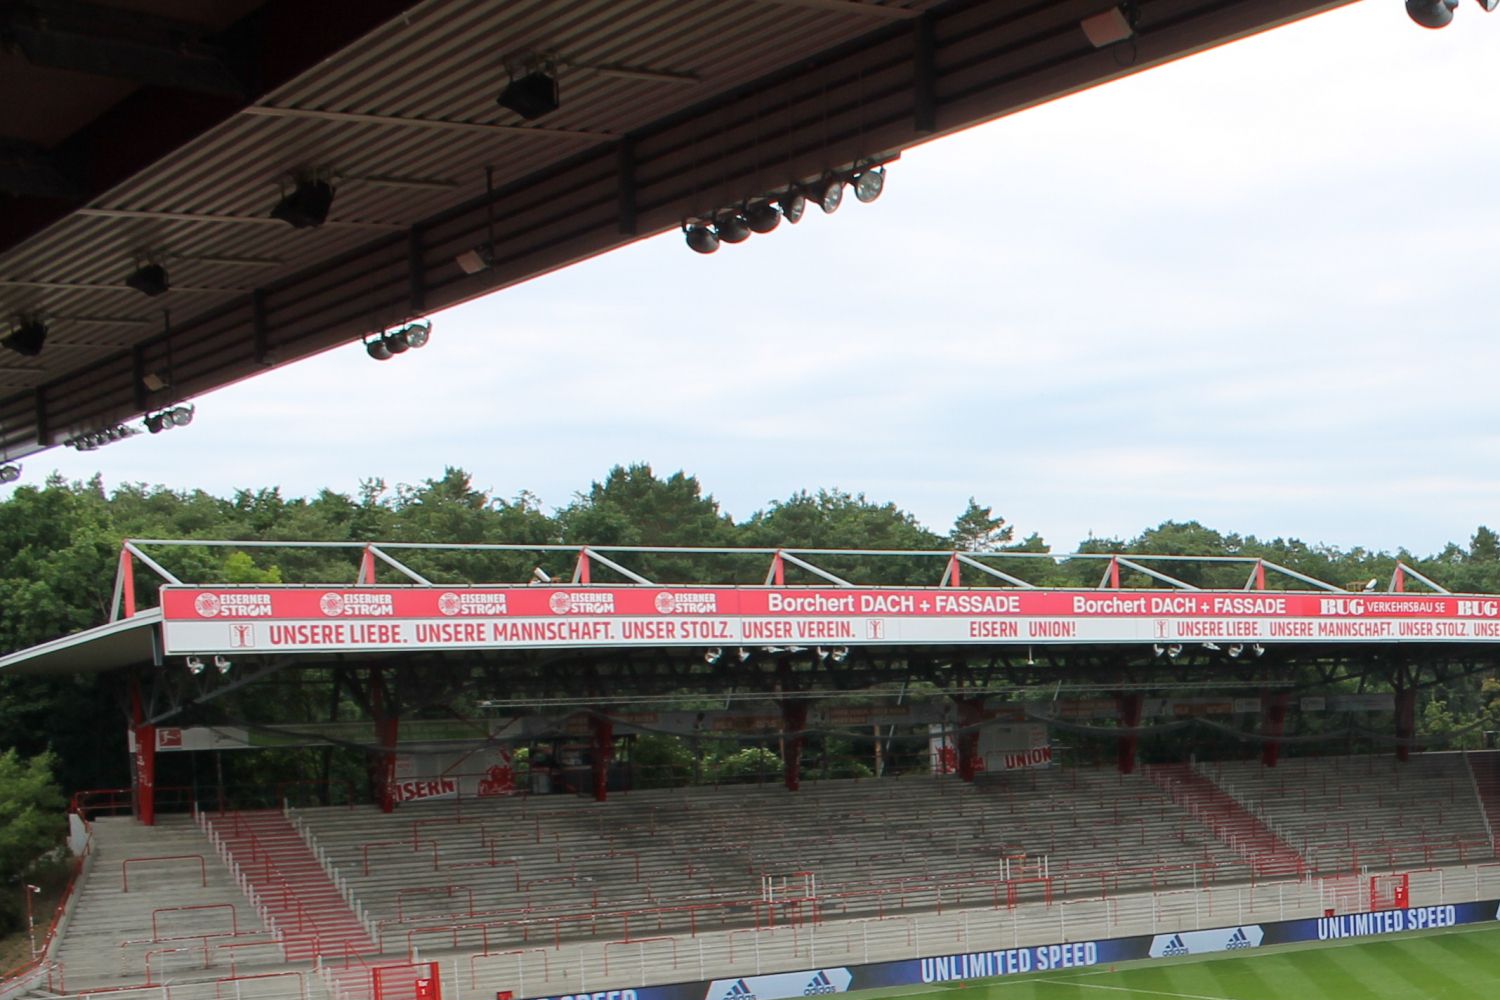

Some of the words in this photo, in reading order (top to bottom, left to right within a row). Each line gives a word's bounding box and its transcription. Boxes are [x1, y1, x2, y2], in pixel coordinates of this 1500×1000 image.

[220, 594, 271, 605] EISERNER
[343, 593, 393, 605] EISERNER
[460, 593, 506, 604] EISERNER
[571, 592, 615, 603] EISERNER
[675, 592, 716, 603] EISERNER
[768, 593, 855, 612] Borchert
[861, 595, 914, 613] DACH
[919, 600, 931, 612] +
[935, 595, 1020, 613] FASSADE
[1073, 596, 1147, 613] Borchert
[1151, 598, 1196, 613] DACH
[1200, 602, 1210, 613] +
[1213, 598, 1286, 614] FASSADE
[1320, 599, 1365, 616] BUG
[1367, 601, 1431, 613] VERKEHRSBAU
[1432, 602, 1446, 613] SE
[1457, 600, 1498, 617] BUG
[269, 624, 345, 645] UNSERE
[350, 623, 408, 645] LIEBE.
[415, 622, 486, 644] UNSERE
[493, 621, 615, 642] MANNSCHAFT.
[622, 621, 676, 640] UNSER
[680, 620, 734, 640] STOLZ.
[742, 621, 793, 639] UNSER
[797, 620, 856, 639] VEREIN.
[970, 620, 1018, 638] EISERN
[1029, 620, 1076, 638] UNION!
[1178, 621, 1224, 637] UNSERE
[1227, 621, 1263, 637] LIEBE.
[1270, 621, 1313, 637] UNSERE
[1318, 621, 1395, 637] MANNSCHAFT.
[1399, 622, 1433, 637] UNSER
[1435, 622, 1470, 637] STOLZ.
[1004, 746, 1052, 769] UNION
[1317, 911, 1403, 940] UNLIMITED
[1406, 905, 1456, 929] SPEED
[1162, 944, 1189, 957] adidas
[1225, 938, 1252, 951] adidas
[920, 949, 1031, 984] UNLIMITED
[1037, 941, 1098, 971] SPEED
[803, 982, 836, 996] adidas
